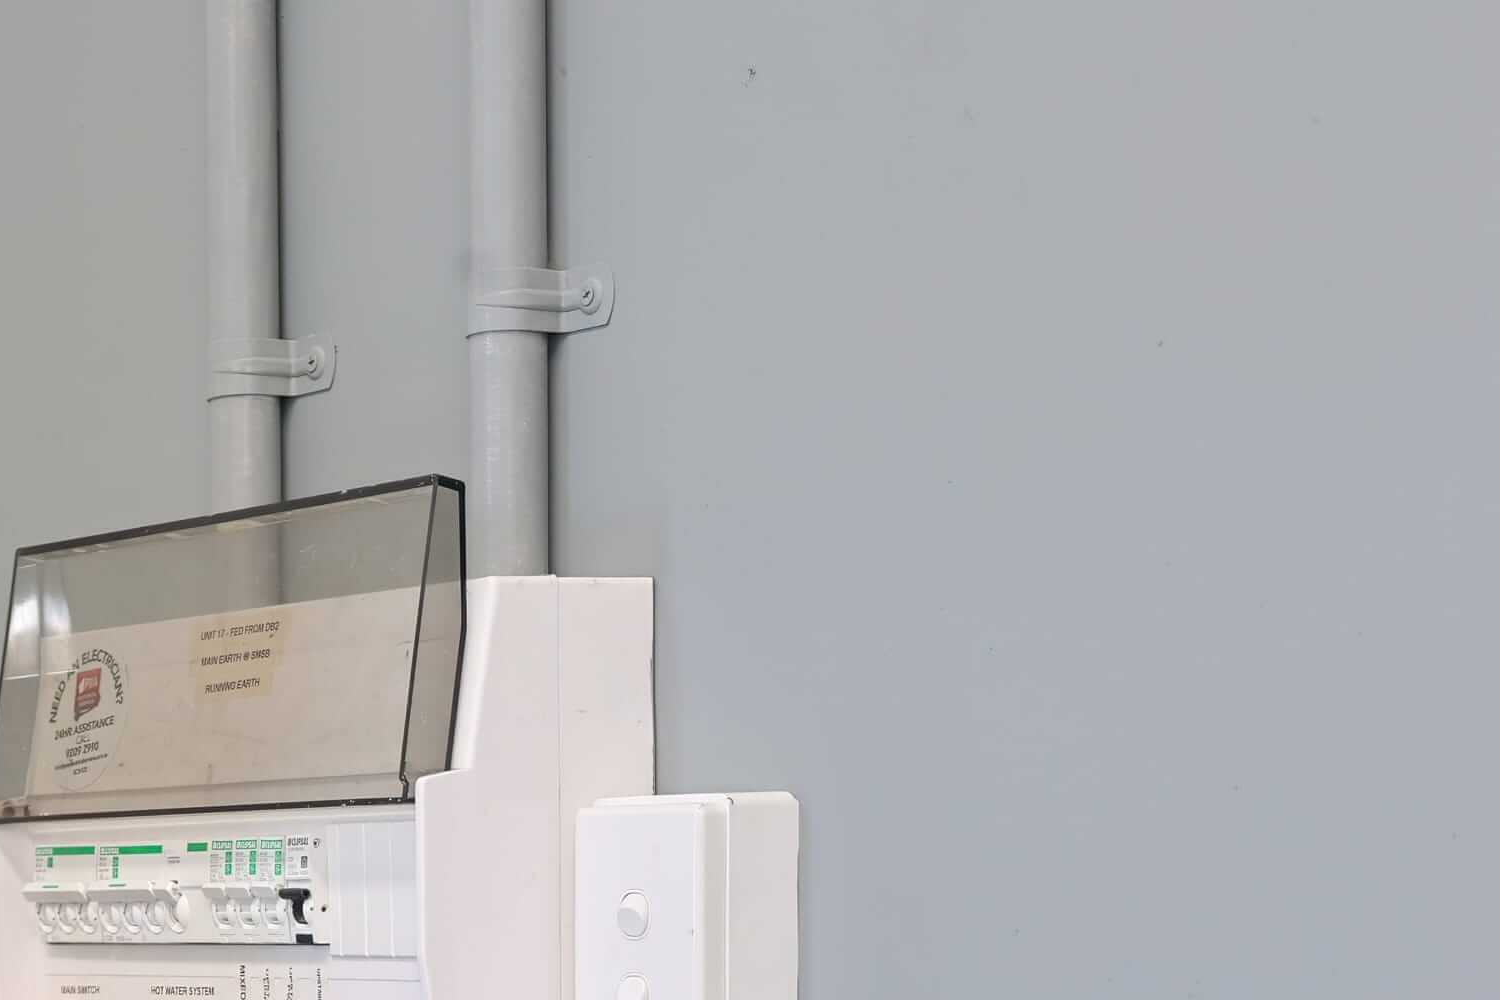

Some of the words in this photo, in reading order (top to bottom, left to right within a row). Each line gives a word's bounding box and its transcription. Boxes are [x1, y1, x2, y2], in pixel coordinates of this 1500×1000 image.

[201, 630, 216, 641] UNIT
[230, 626, 244, 637] FED
[245, 623, 264, 635] FROM
[201, 656, 218, 666] MAIN
[219, 652, 242, 664] EARTH
[205, 680, 236, 694] RUNNING
[236, 677, 260, 689] EARTH
[49, 680, 66, 723] NEED
[74, 715, 115, 734] ASSISTANCE
[61, 985, 75, 995] MAIN
[76, 985, 100, 995] SWITCH
[150, 985, 164, 996] HOT
[165, 985, 188, 996] WATER
[188, 986, 215, 996] SYSTEM
